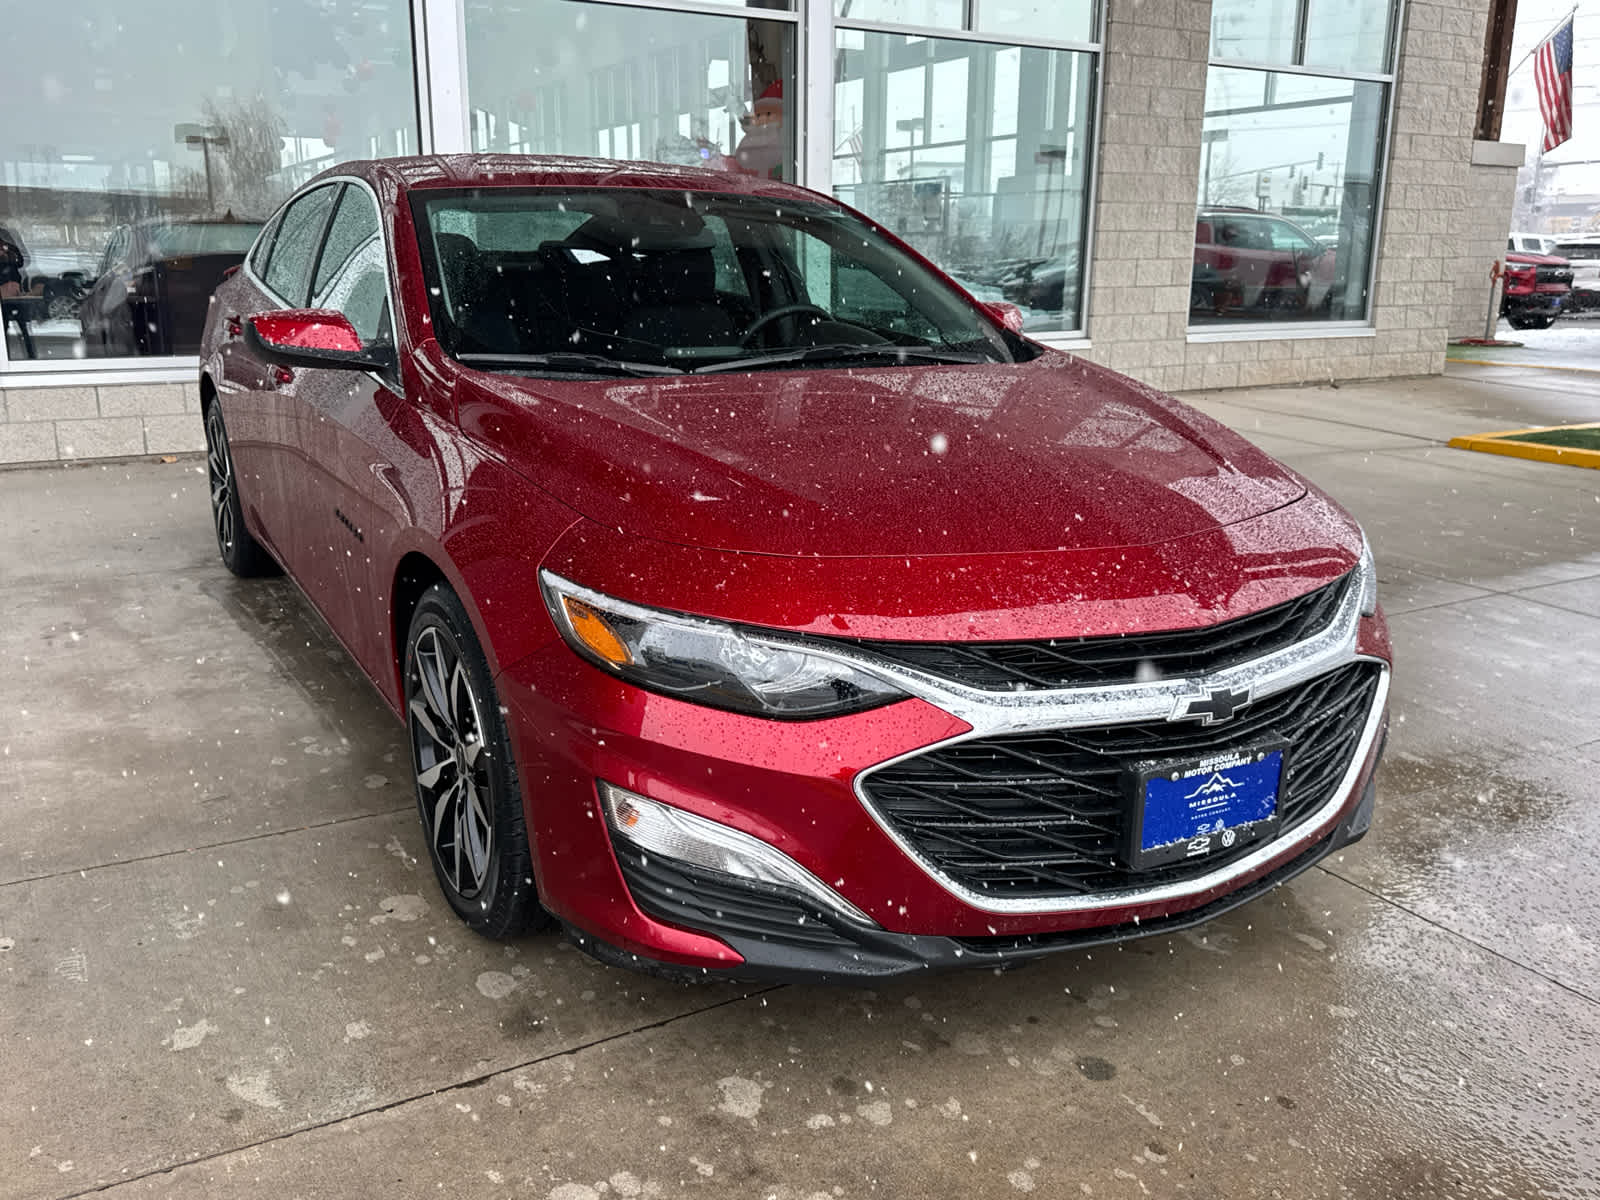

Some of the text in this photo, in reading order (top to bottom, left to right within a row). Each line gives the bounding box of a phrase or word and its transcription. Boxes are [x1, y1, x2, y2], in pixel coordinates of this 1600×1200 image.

[1184, 756, 1252, 779] MOTOR COMPANY
[1199, 752, 1240, 767] MISSOULA
[1189, 792, 1237, 808] MISSOULA
